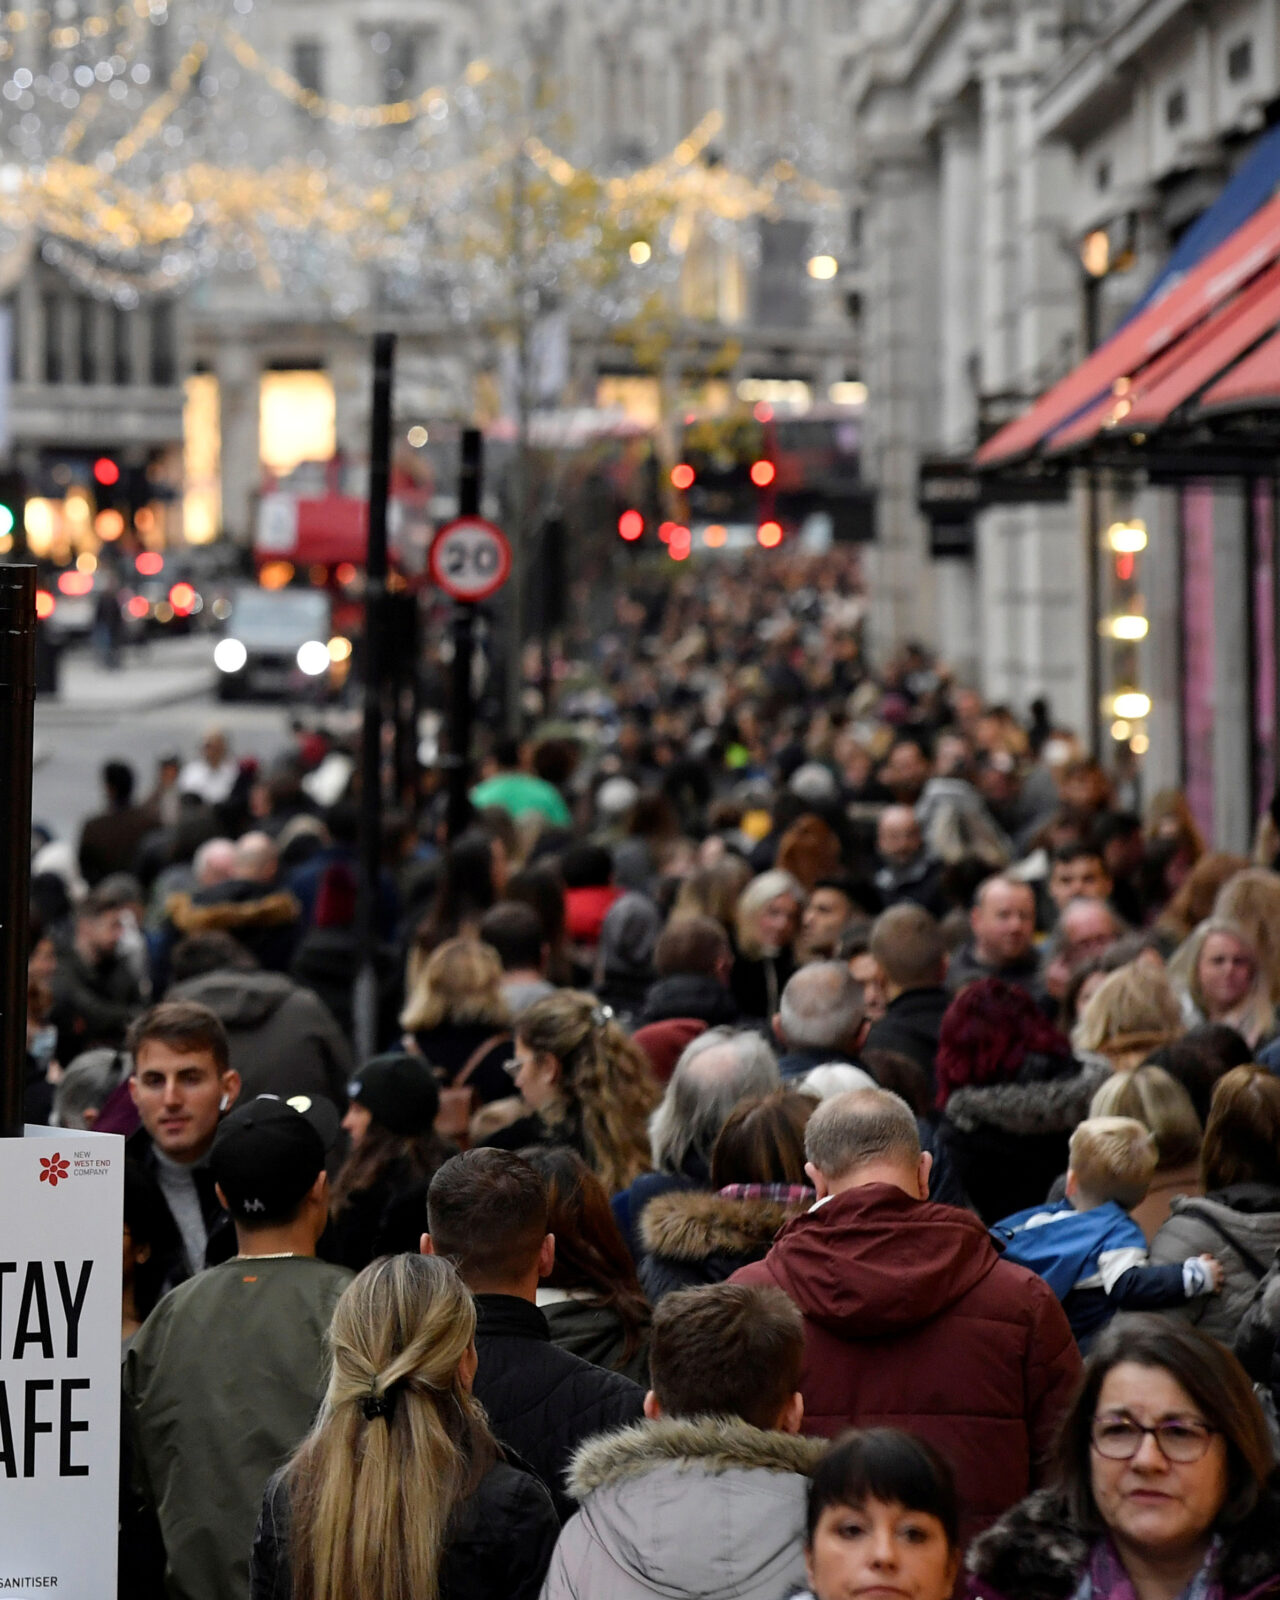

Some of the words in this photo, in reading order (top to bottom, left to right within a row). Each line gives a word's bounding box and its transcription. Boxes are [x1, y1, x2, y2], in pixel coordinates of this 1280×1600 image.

[446, 541, 499, 576] 20
[95, 1159, 111, 1167] END
[73, 1168, 109, 1176] COMPANY
